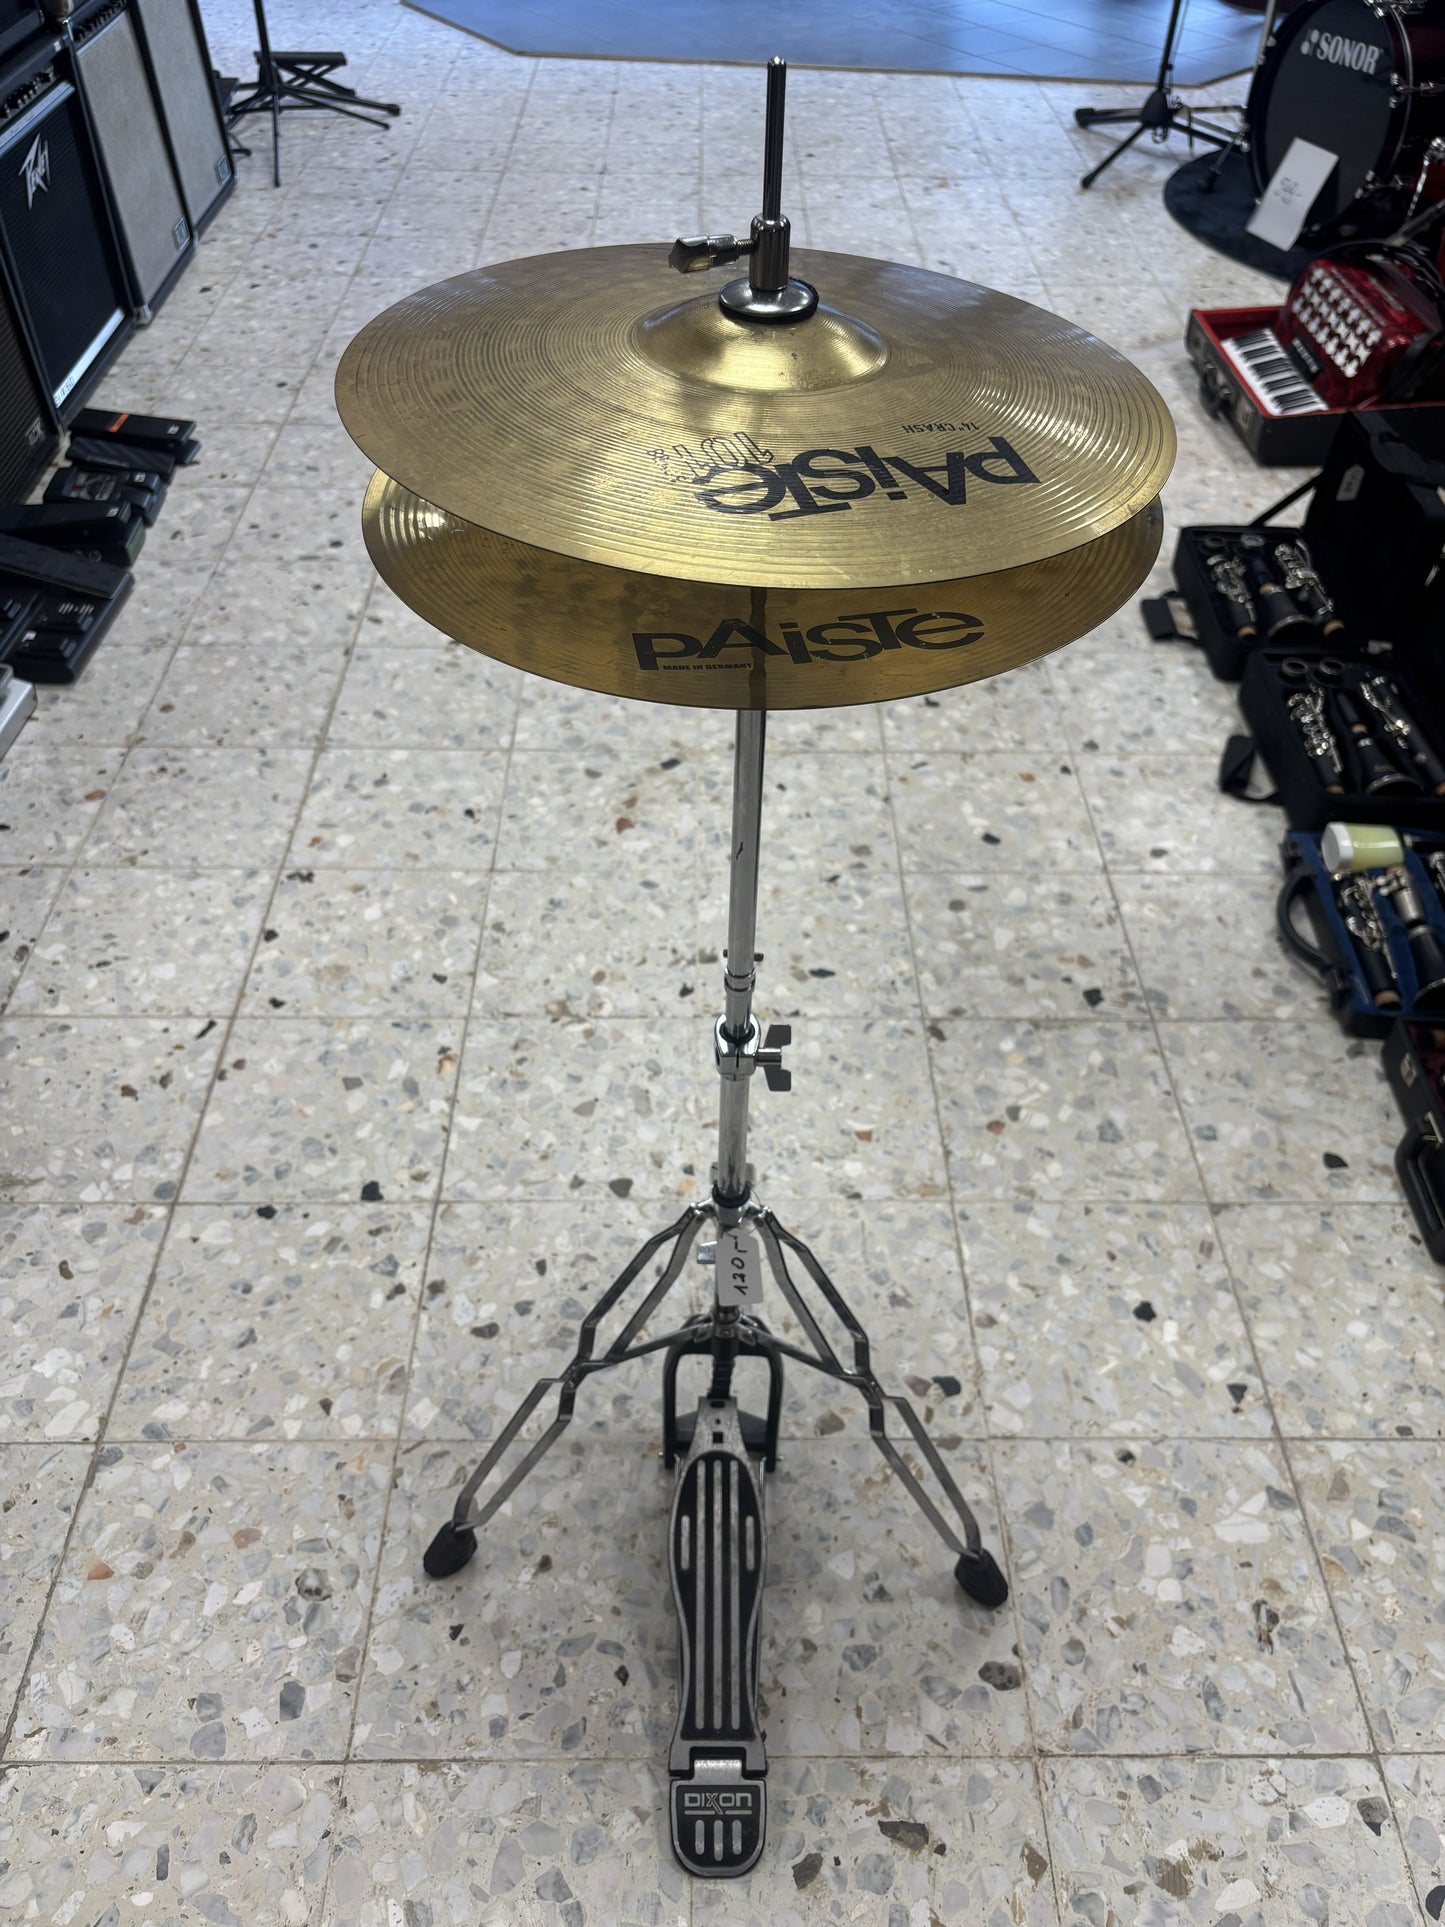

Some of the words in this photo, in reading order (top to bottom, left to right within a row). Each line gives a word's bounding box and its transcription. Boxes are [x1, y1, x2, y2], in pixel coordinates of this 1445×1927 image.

[1316, 32, 1382, 75] SONOR
[901, 422, 956, 433] CRASH
[705, 662, 753, 670] GERMANY
